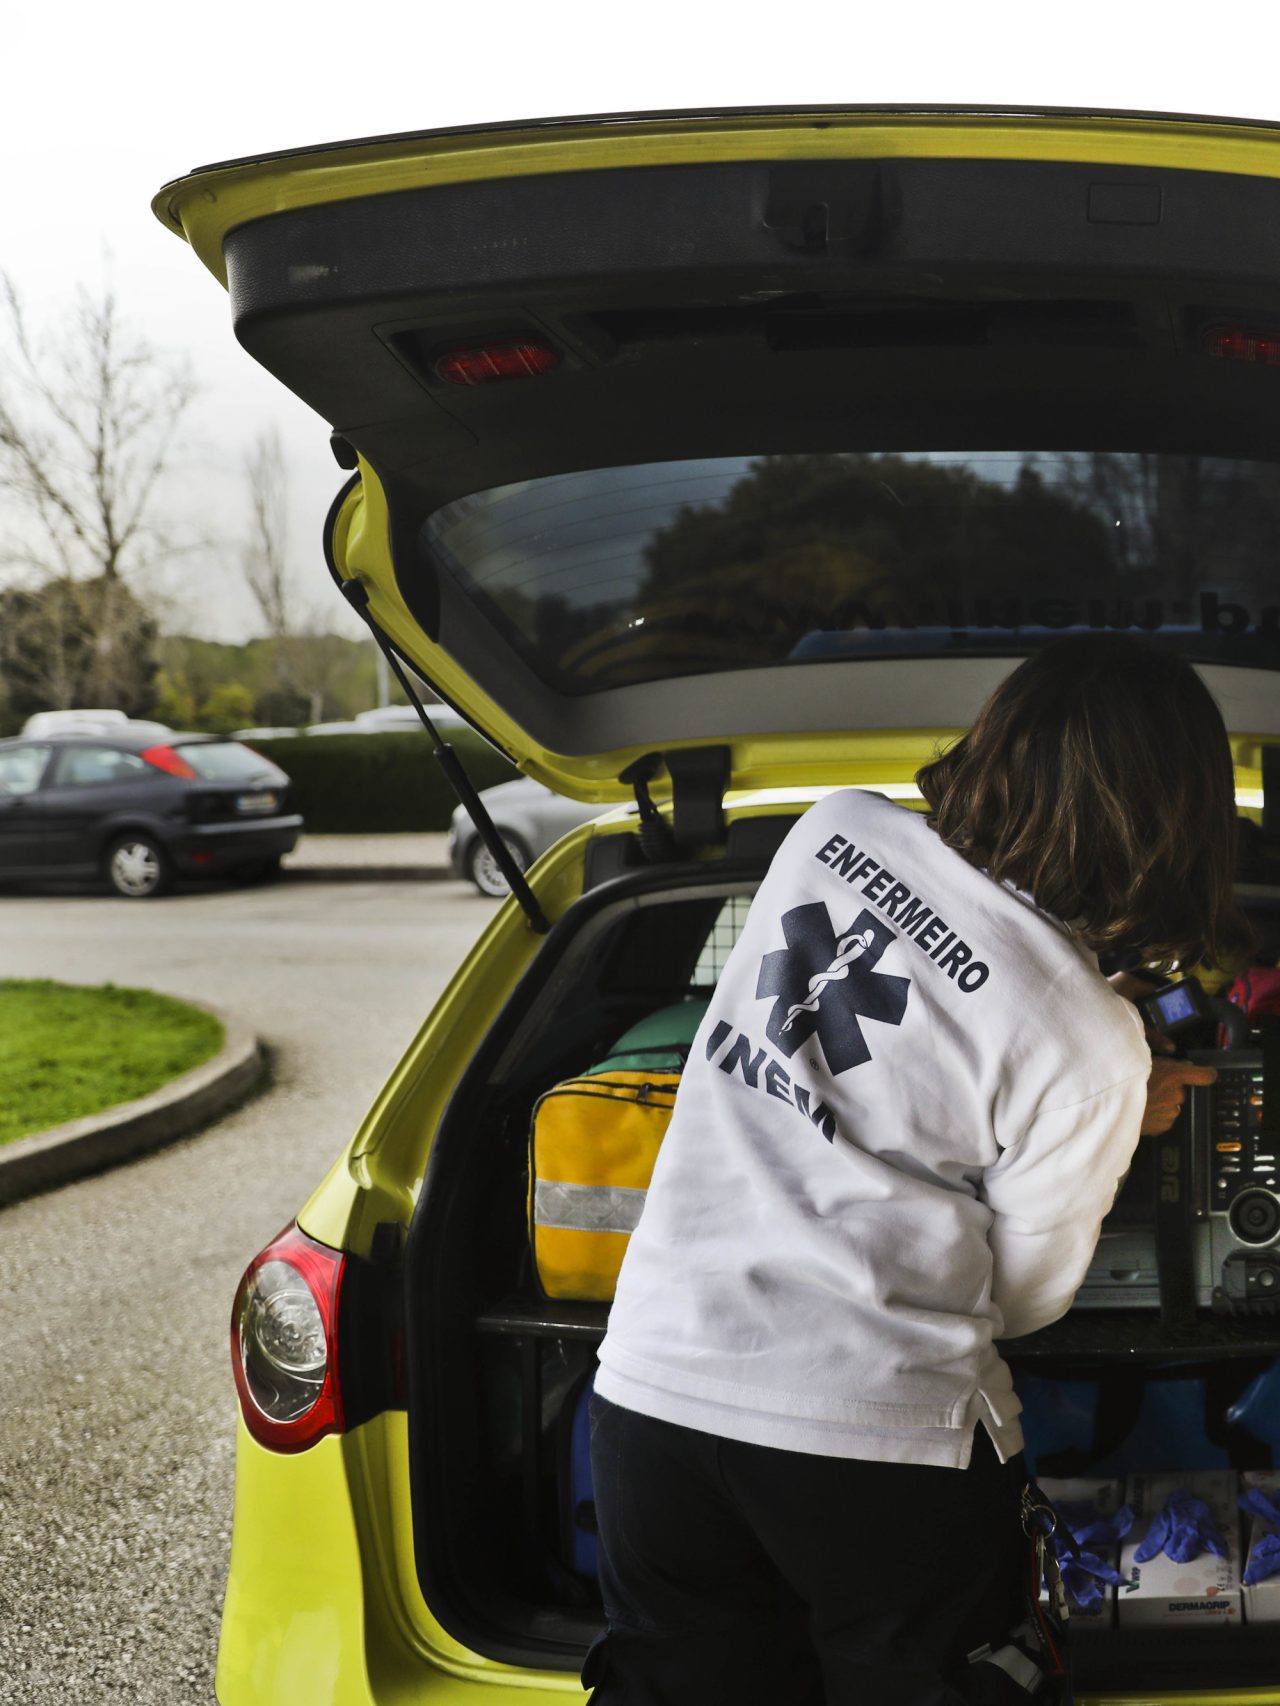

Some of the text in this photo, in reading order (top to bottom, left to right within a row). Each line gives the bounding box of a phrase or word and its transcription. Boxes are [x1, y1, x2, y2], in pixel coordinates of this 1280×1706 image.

[815, 834, 990, 993] ENFERMEIRO
[706, 1020, 836, 1144] INEM
[1169, 1600, 1230, 1612] DERMAGRIP
